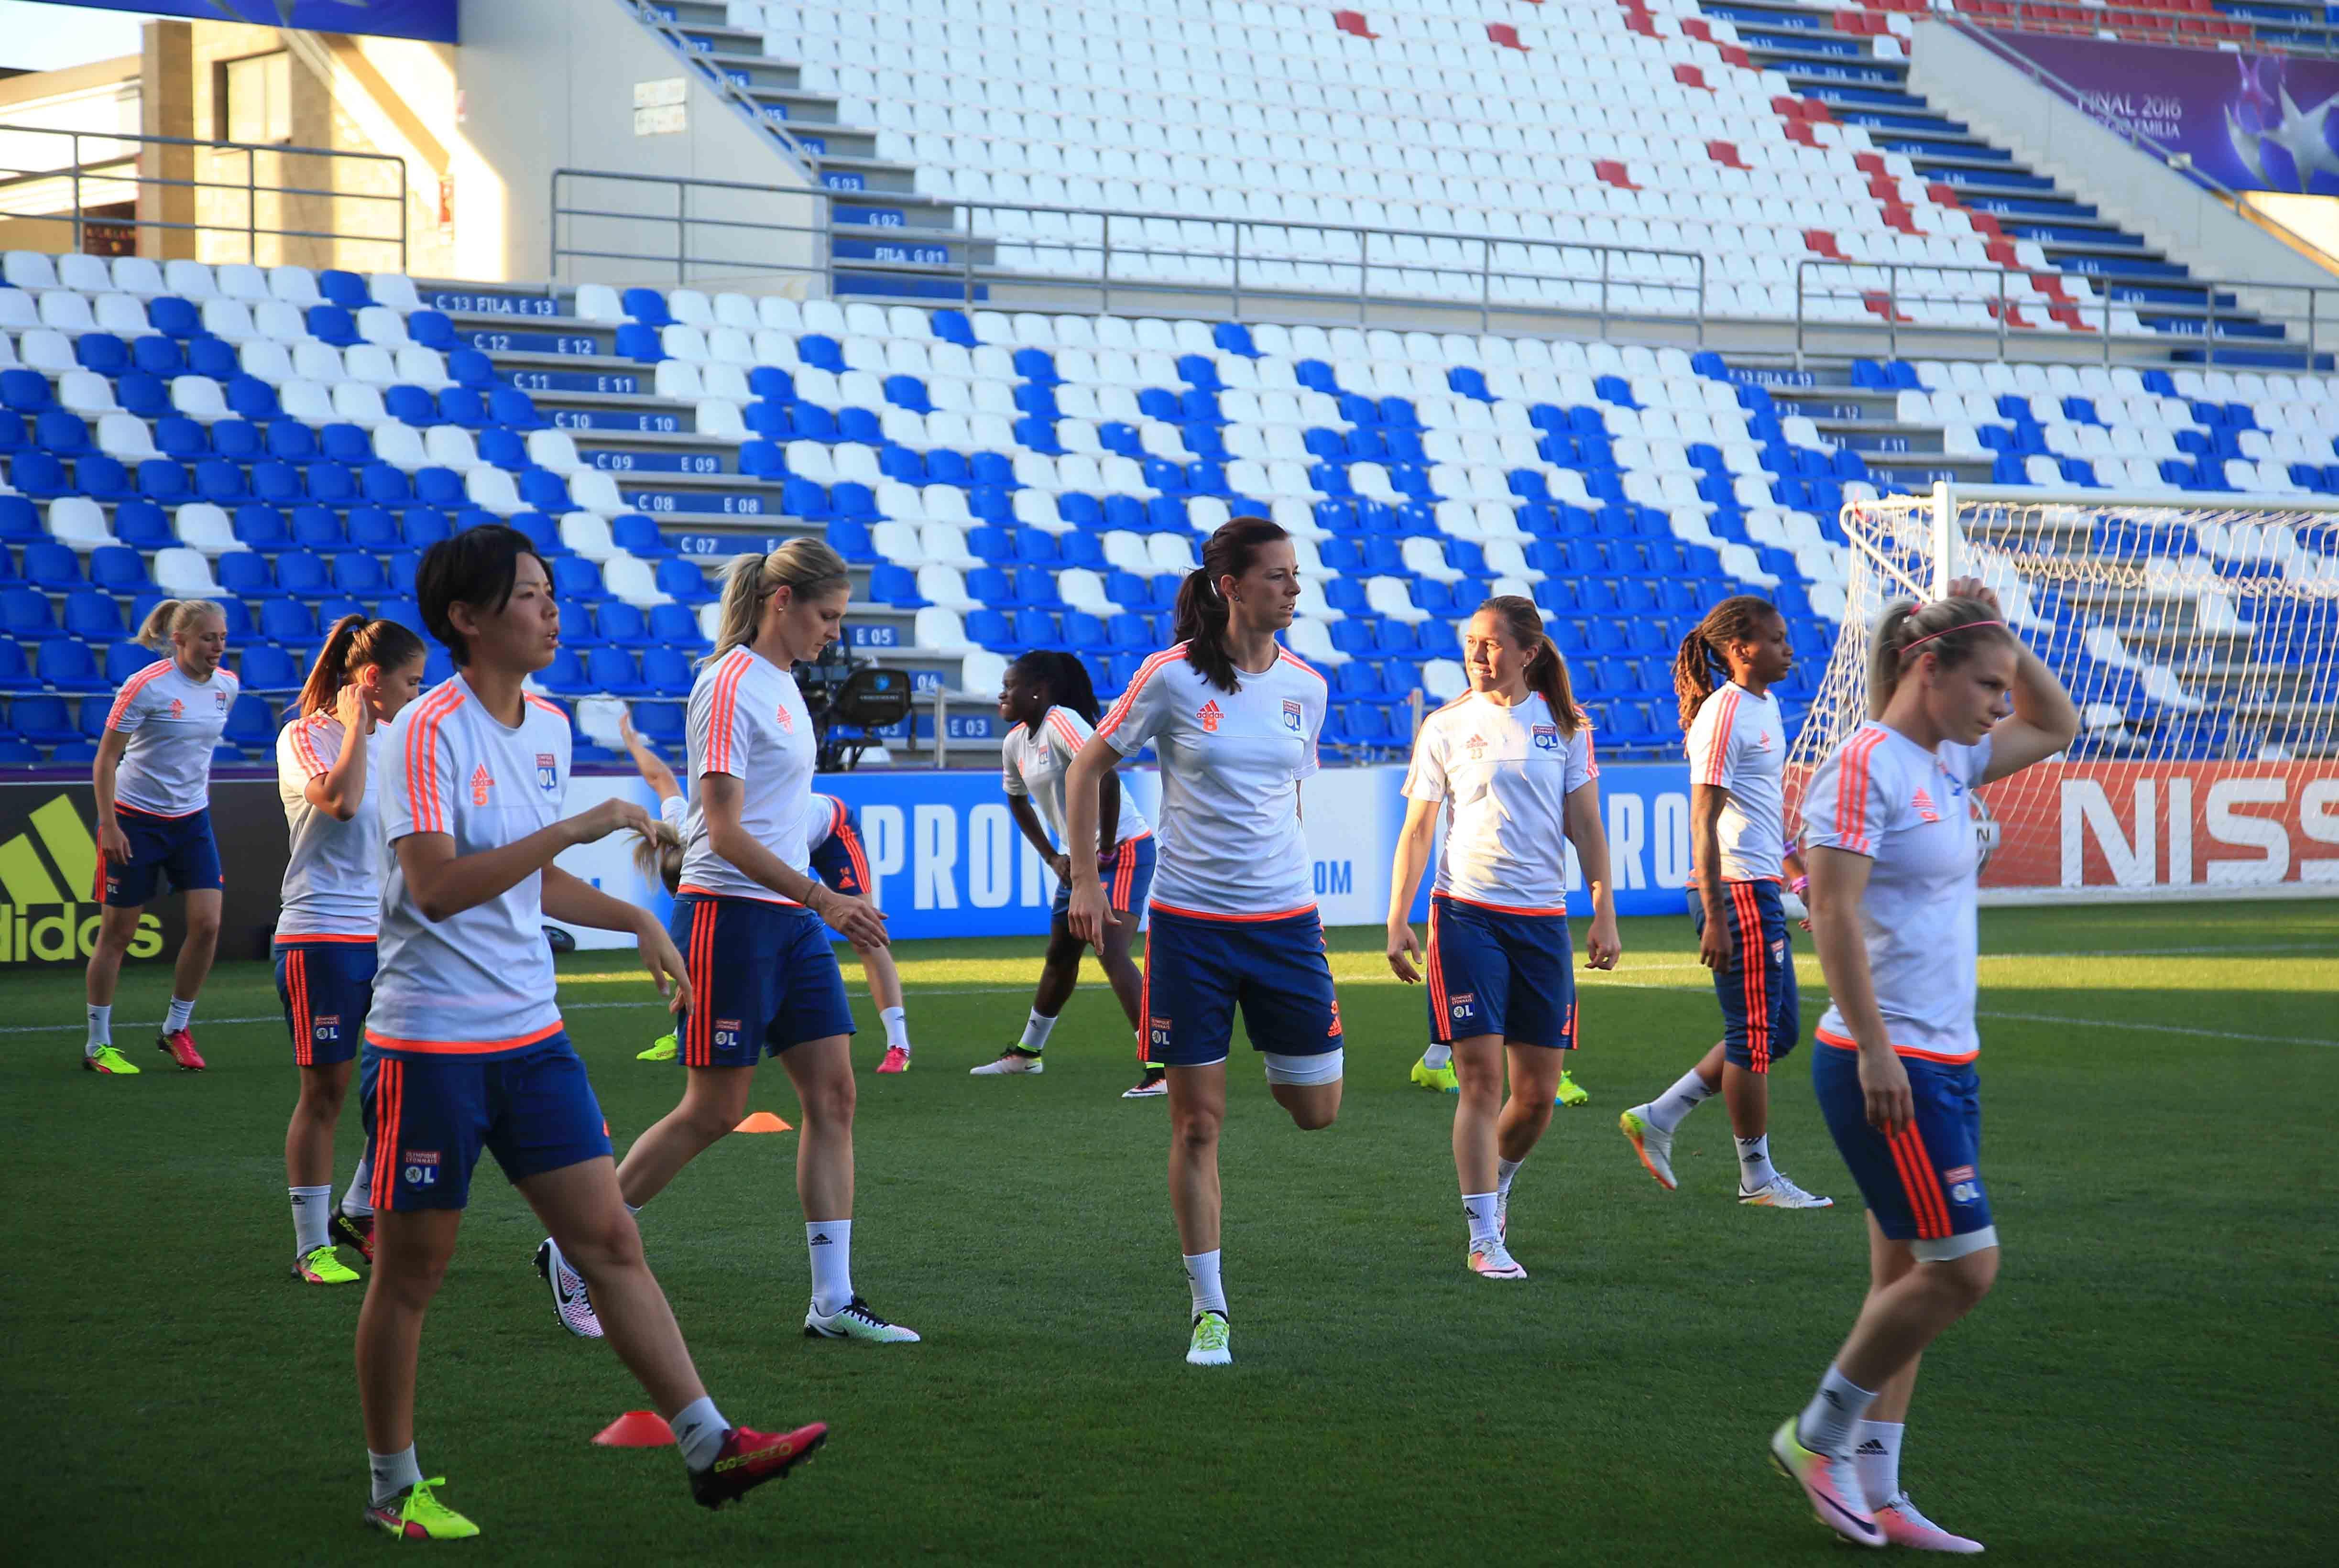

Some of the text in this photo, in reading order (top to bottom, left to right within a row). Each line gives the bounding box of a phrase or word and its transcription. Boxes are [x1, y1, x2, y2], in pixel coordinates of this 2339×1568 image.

[2142, 94, 2182, 120] 2016
[875, 247, 906, 262] FILA
[437, 294, 553, 316] C 13 FILA E 13
[474, 334, 592, 354] C 12 E 12
[514, 373, 632, 393] C 11 E 11
[555, 413, 674, 432] C 10 E 10
[597, 453, 715, 473] C 09 E 09
[638, 494, 758, 513] C 08 E 08
[681, 536, 776, 554] C 07 E
[856, 628, 892, 645] E 05
[917, 674, 937, 692] 04
[1196, 710, 1224, 719] adidas
[1285, 712, 1299, 729] OL
[951, 718, 961, 737] E
[966, 719, 986, 737] 03
[1203, 718, 1217, 731] 8
[1536, 735, 1557, 747] OL
[1471, 748, 1483, 759] 23
[538, 769, 556, 787] OL
[473, 787, 489, 806] 5
[107, 884, 119, 894] OL
[0, 902, 163, 962] ids
[1453, 1005, 1474, 1018] OL
[316, 1027, 338, 1039] OL
[715, 1031, 737, 1046] OL
[1151, 1030, 1170, 1045] OL
[405, 1166, 435, 1184] OL
[1952, 1182, 1981, 1202] OL
